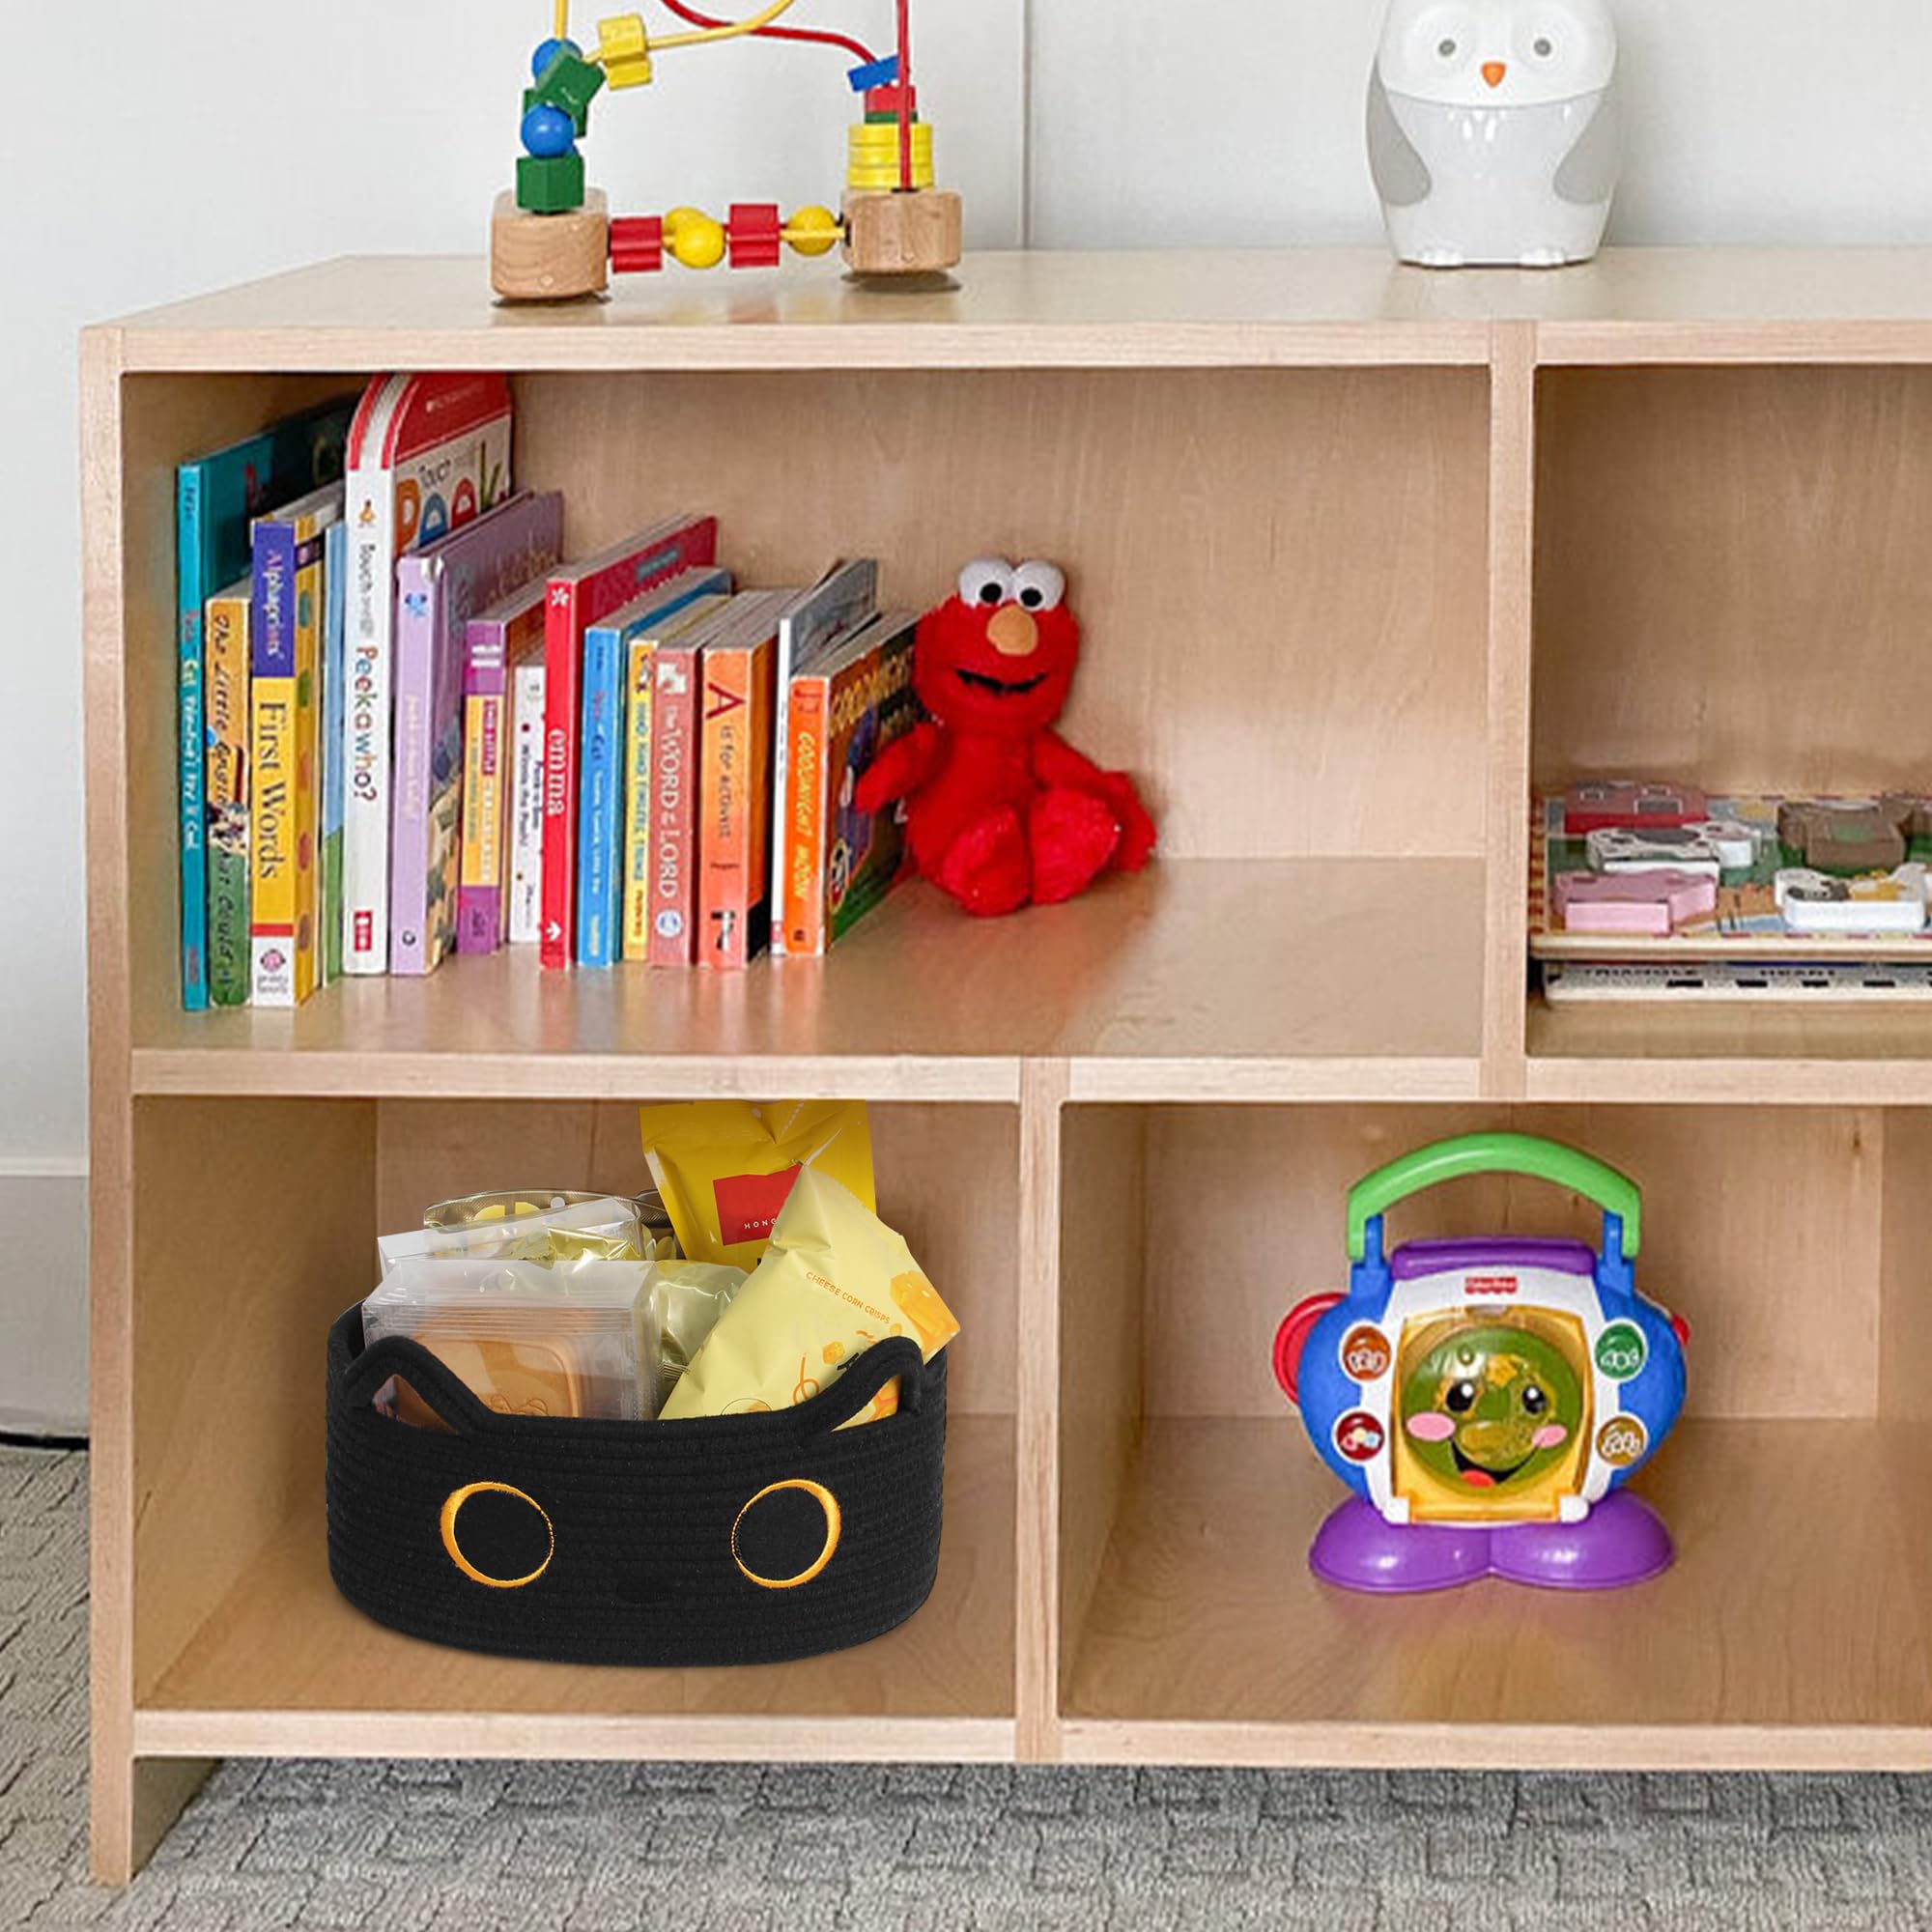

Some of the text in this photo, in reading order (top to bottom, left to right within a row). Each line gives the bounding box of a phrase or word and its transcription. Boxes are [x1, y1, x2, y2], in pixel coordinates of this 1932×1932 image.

[214, 661, 232, 731] Little
[706, 682, 746, 719] A
[257, 702, 287, 878] First Words
[549, 728, 566, 815] emma
[661, 728, 681, 810] WORD
[793, 731, 816, 902] GOODNIGHT MOON
[658, 830, 680, 898] LORD
[217, 895, 235, 961] Could
[806, 1271, 892, 1324] CHEESE CORN CRISPS
